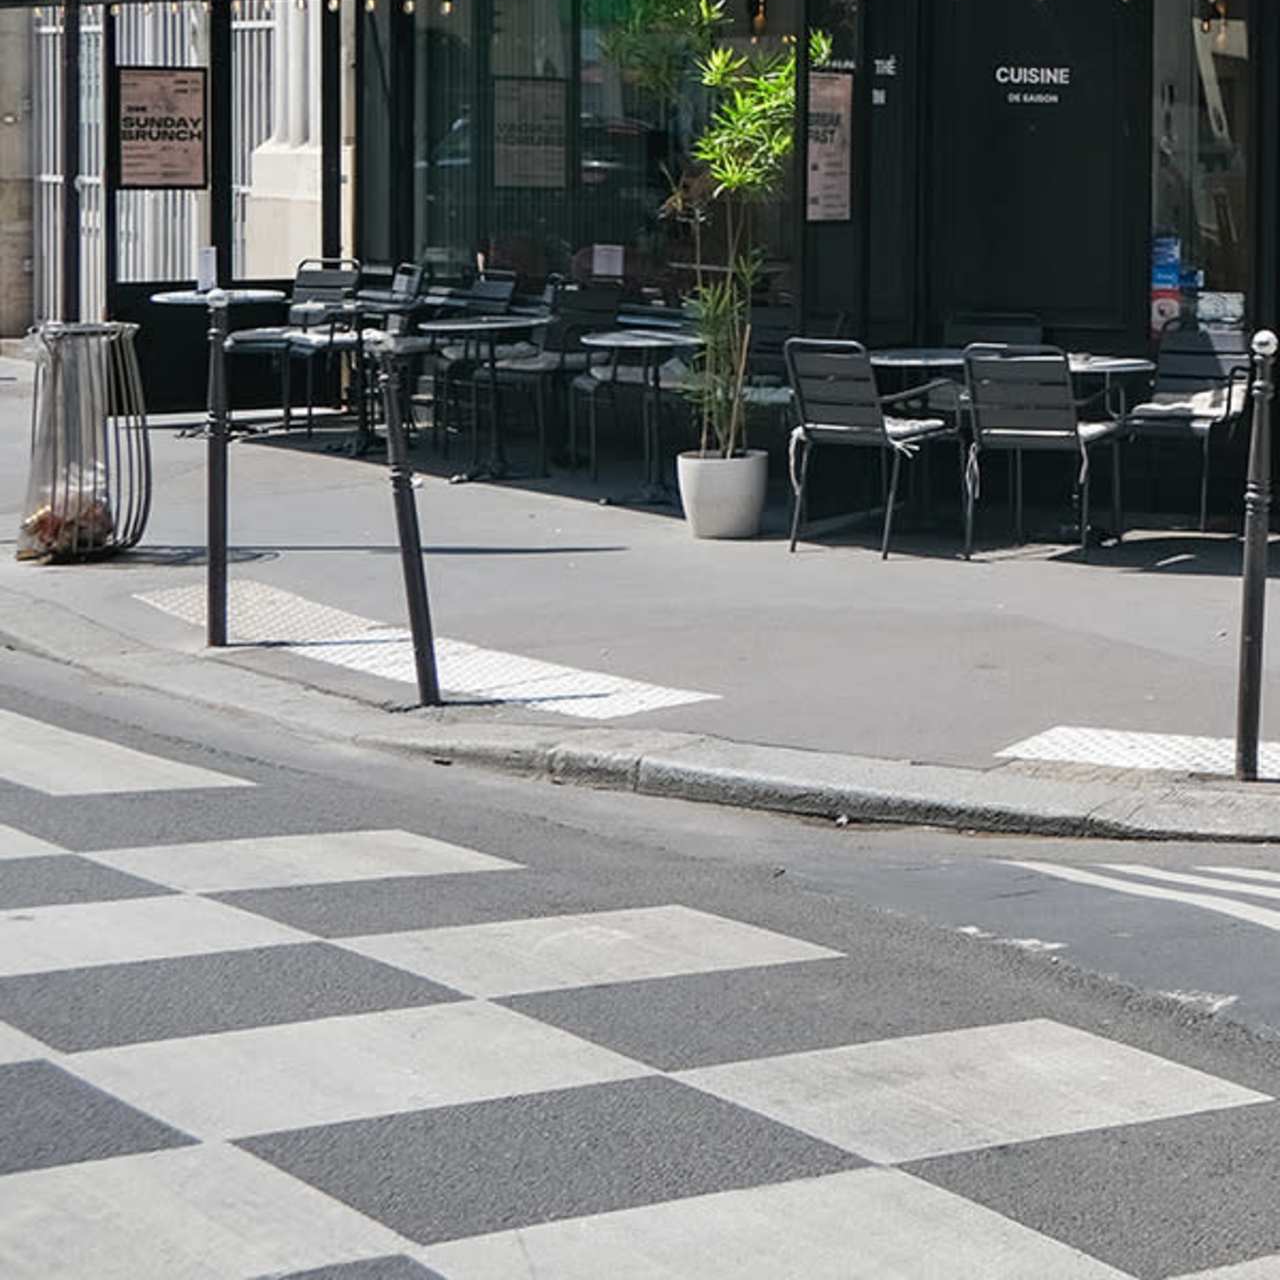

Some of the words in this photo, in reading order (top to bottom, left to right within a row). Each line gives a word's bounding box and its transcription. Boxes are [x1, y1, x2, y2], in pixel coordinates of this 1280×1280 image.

[995, 66, 1070, 84] CUISINE
[121, 116, 202, 129] SUNDAY
[121, 129, 202, 141] BRUNCH
